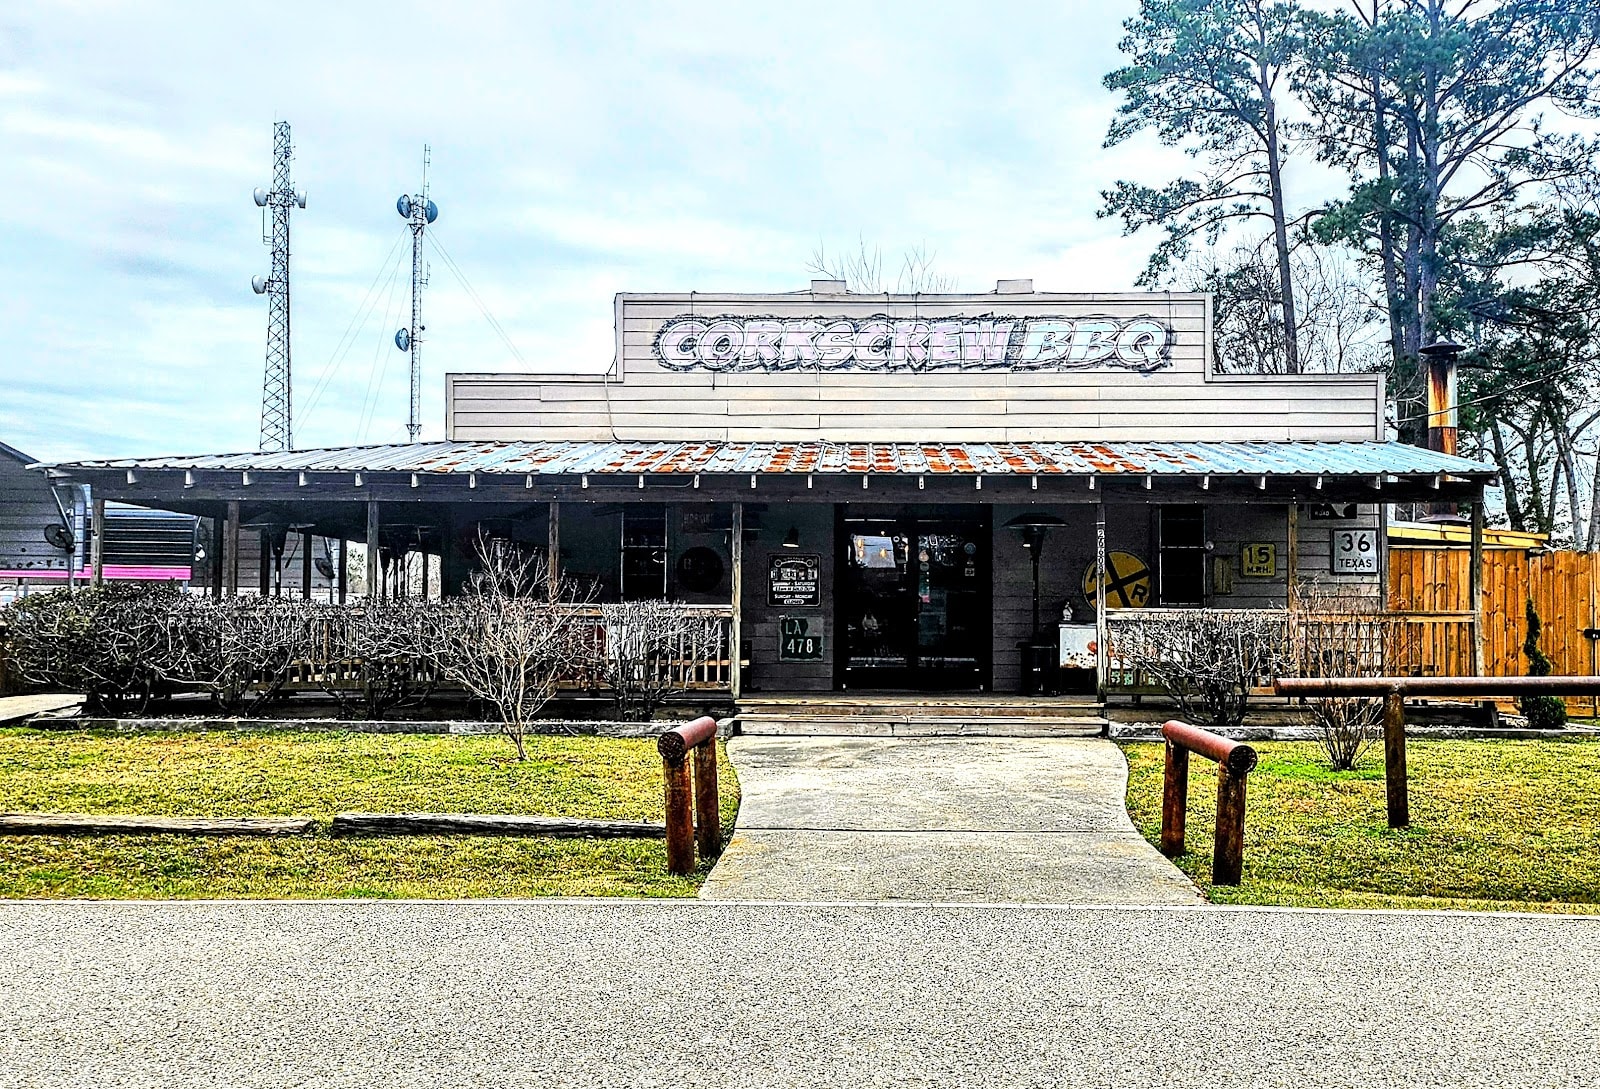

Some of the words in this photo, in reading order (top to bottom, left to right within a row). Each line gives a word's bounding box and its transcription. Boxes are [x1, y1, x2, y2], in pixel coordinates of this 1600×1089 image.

[656, 317, 1015, 369] CORKSCREW
[1016, 317, 1172, 371] BBQ
[1340, 532, 1371, 552] 36
[1247, 546, 1271, 564] 15
[1339, 558, 1372, 568] TEXAS
[1130, 583, 1148, 603] R
[785, 619, 802, 635] LA
[787, 638, 814, 654] 478
